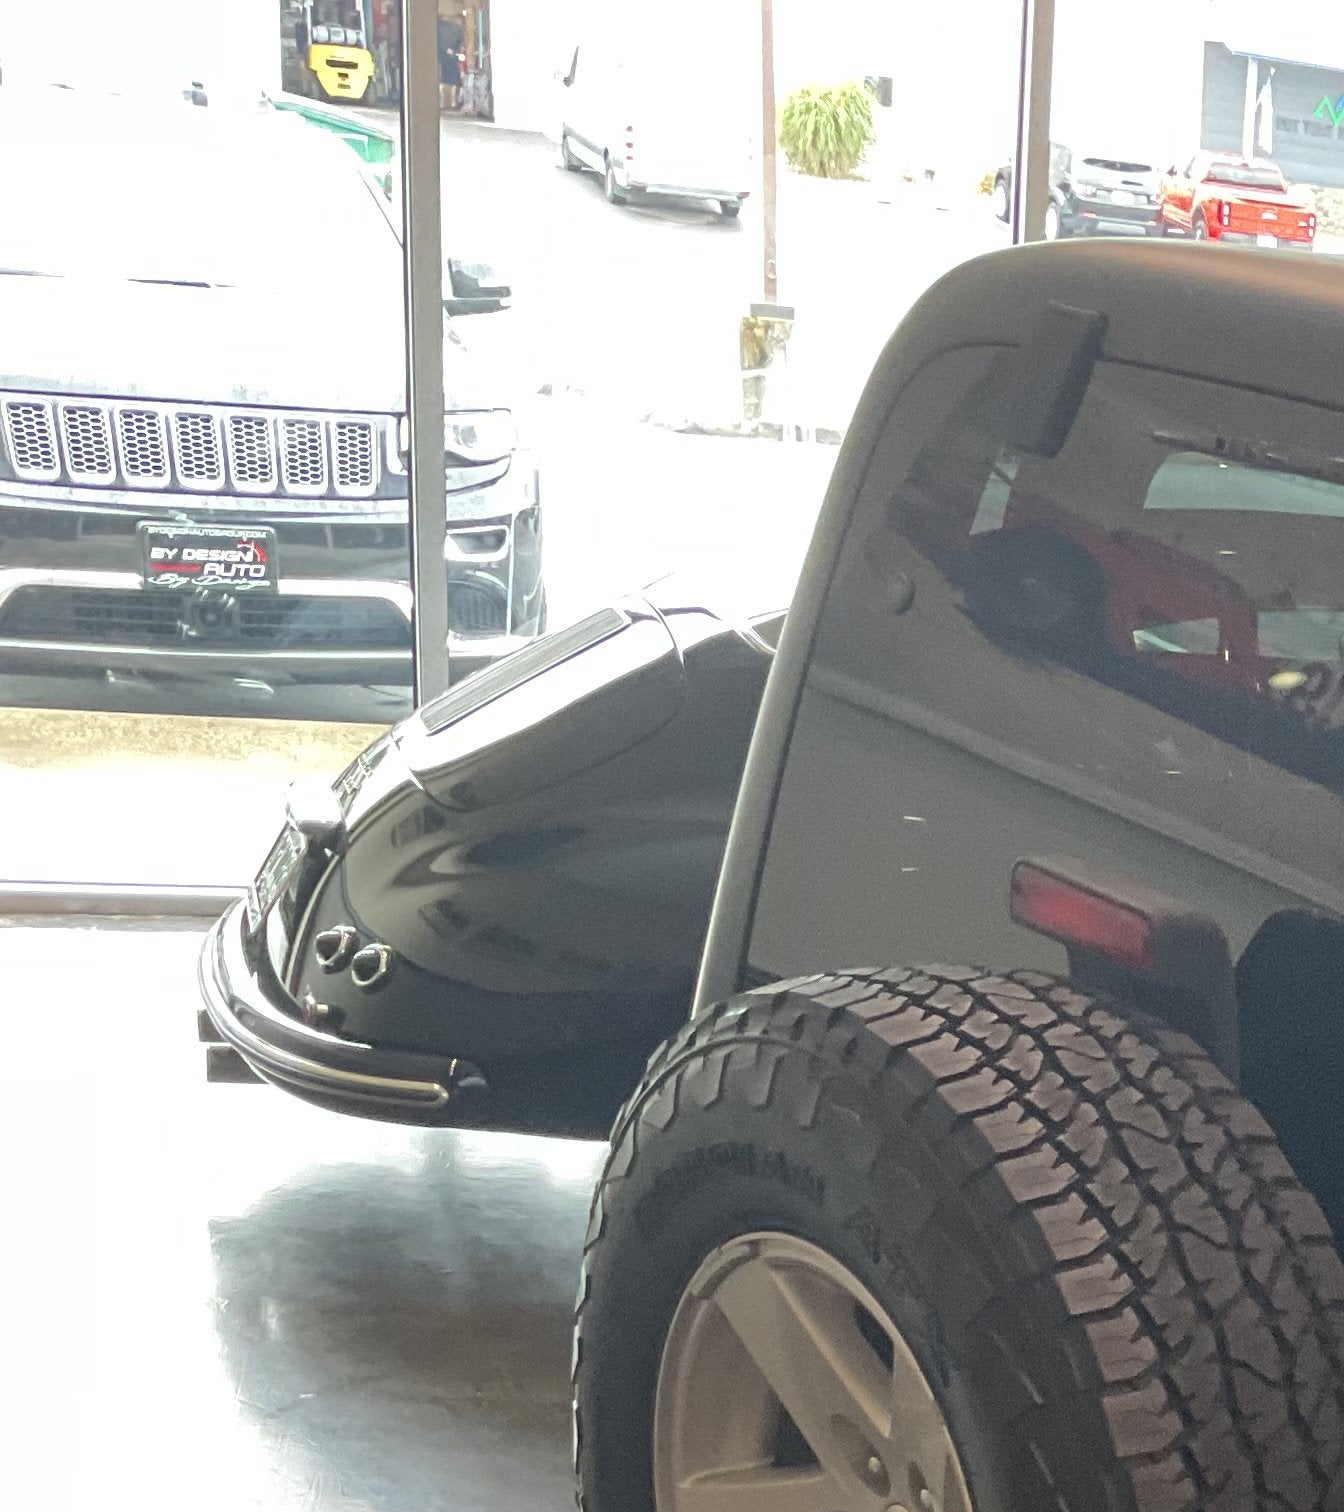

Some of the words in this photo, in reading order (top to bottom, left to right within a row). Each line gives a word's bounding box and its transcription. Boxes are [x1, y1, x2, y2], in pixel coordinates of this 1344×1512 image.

[150, 547, 179, 560] BY
[182, 547, 255, 563] DESIGN
[203, 563, 266, 578] AUTO
